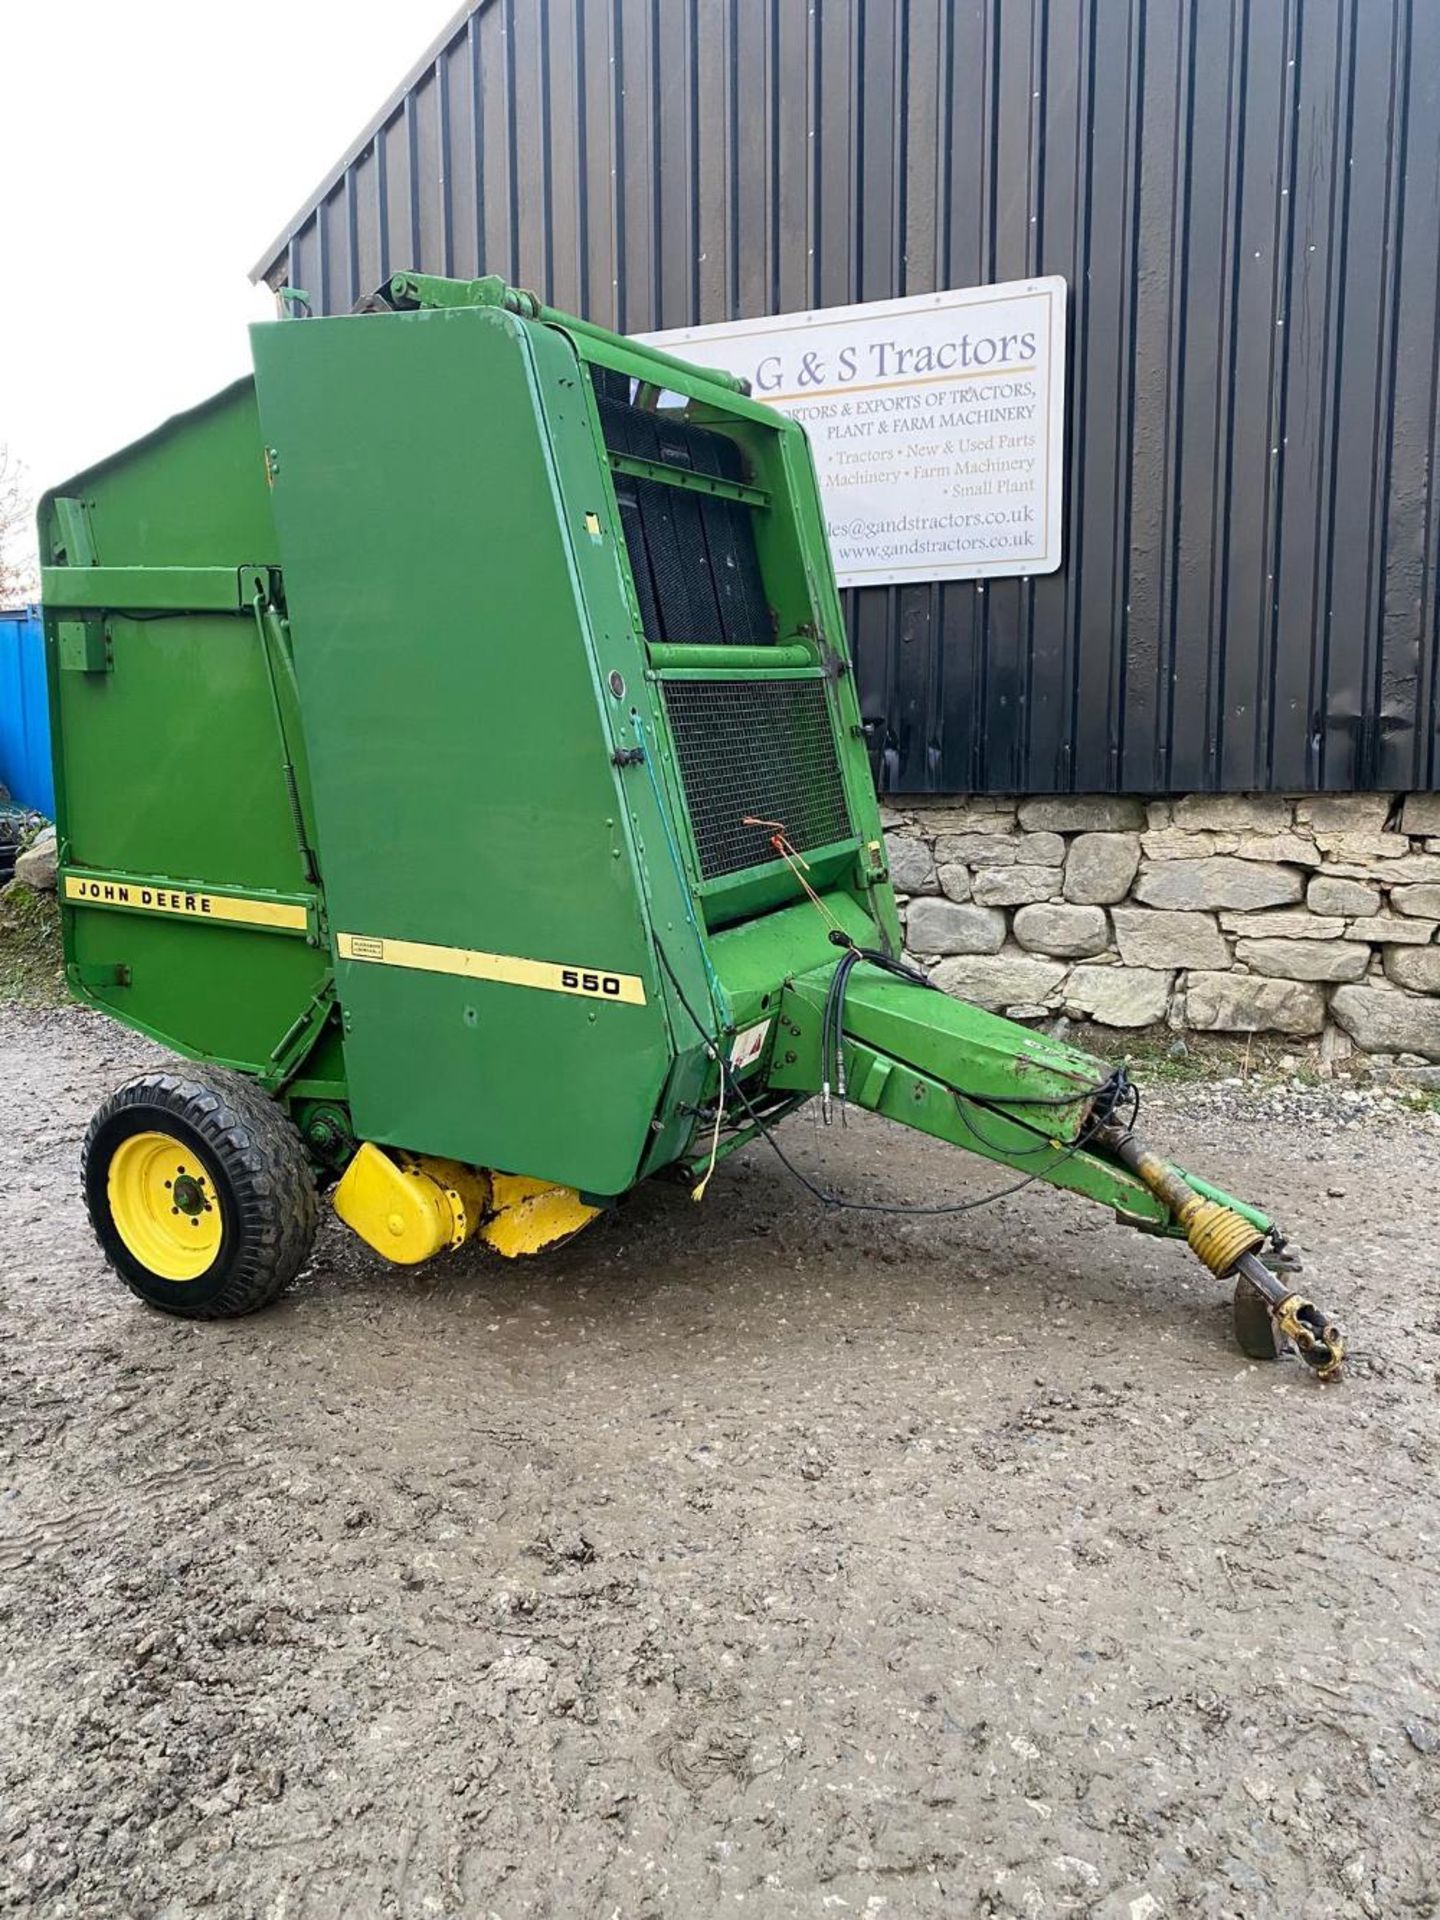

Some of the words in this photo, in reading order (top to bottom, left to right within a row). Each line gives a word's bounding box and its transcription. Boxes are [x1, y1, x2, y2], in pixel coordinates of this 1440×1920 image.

[756, 357, 783, 390] G
[797, 351, 826, 386] &
[838, 346, 857, 382] S
[869, 332, 1036, 377] Tractors
[841, 403, 852, 416] &
[856, 394, 921, 415] EXPORTS
[925, 391, 946, 407] OF
[949, 382, 1037, 405] TRACTORS,
[828, 421, 875, 440] PLANT
[878, 420, 889, 435] &
[893, 415, 935, 433] FARM
[940, 404, 1036, 428] MACHINERY
[835, 448, 894, 465] Tractors
[907, 443, 940, 458] New
[943, 439, 954, 454] &
[959, 435, 994, 453] Used
[999, 434, 1036, 449] Parts
[826, 470, 901, 487] Machinery
[913, 465, 950, 479] Farm
[954, 458, 1035, 476] Machinery
[951, 480, 992, 498] Small
[998, 479, 1035, 494] Plant
[839, 530, 1036, 560] www.gandstractors.co.uk
[79, 882, 129, 902] JOHN
[141, 890, 212, 913] DEERE
[562, 970, 620, 995] 550
